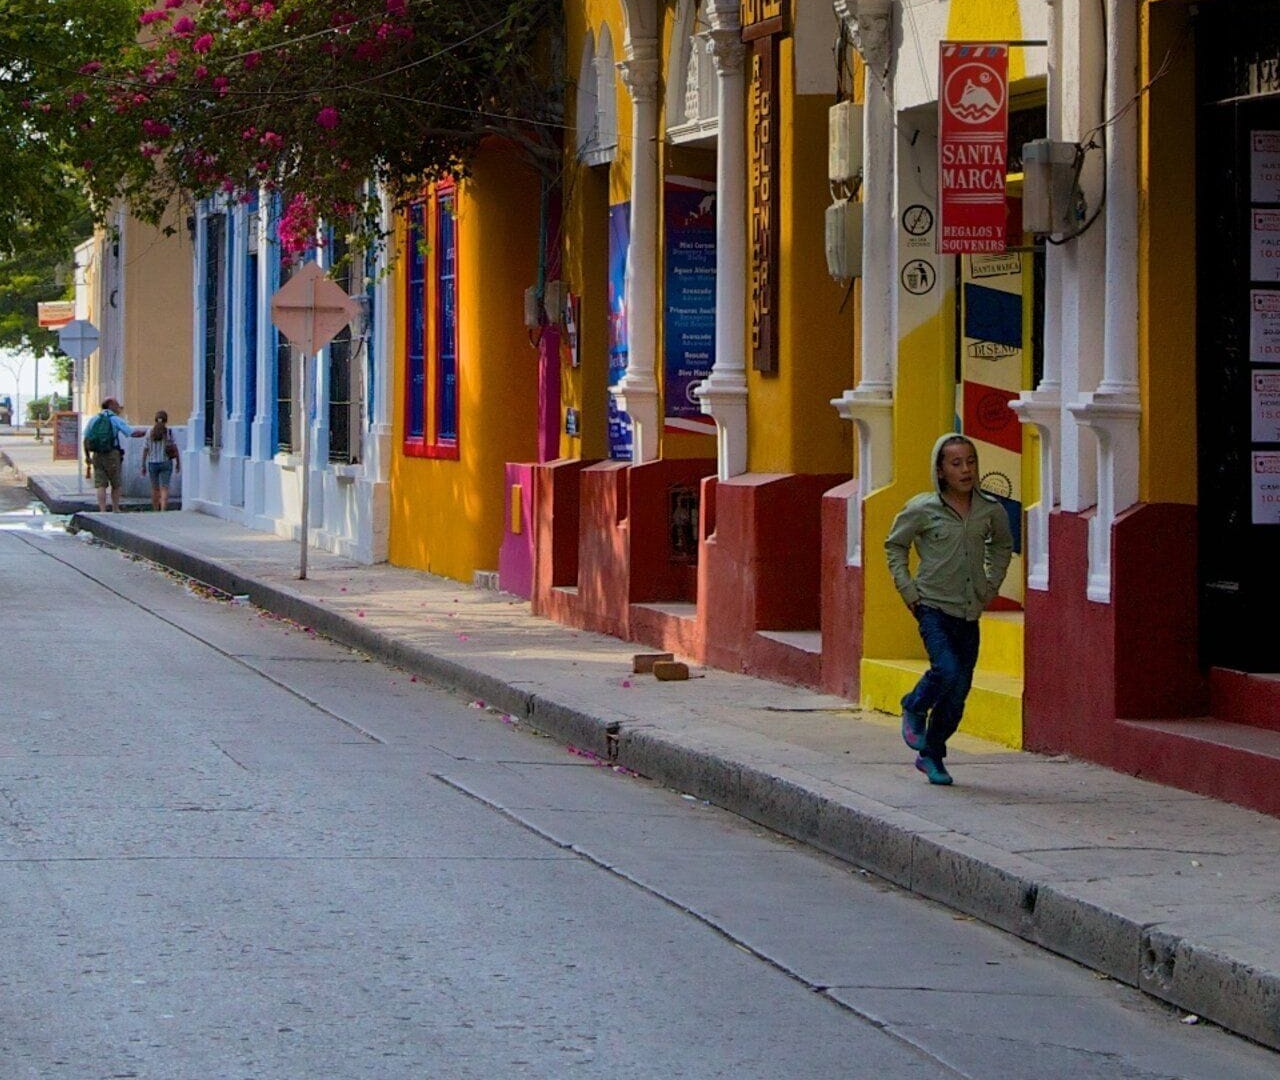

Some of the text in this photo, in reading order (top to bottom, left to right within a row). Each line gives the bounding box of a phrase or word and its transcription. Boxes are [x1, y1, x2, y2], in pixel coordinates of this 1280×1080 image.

[943, 144, 1005, 165] SANTA
[943, 169, 1005, 190] MARCA
[761, 91, 770, 315] COLONIAL
[944, 226, 1004, 237] REGALOS Y
[942, 240, 1005, 251] SOUVENIRS
